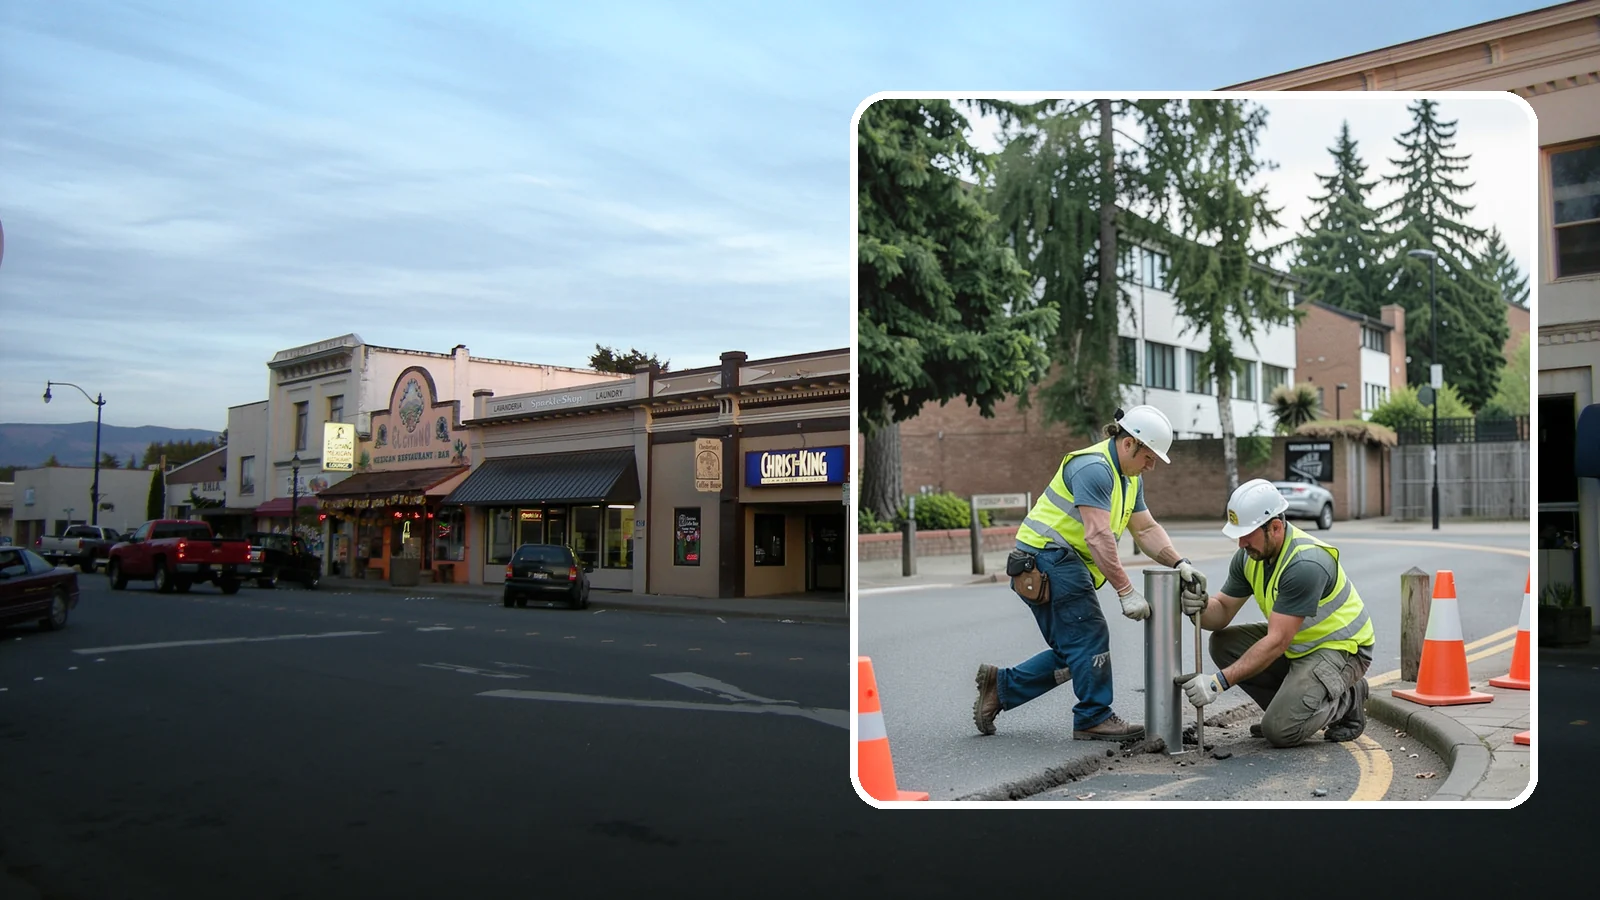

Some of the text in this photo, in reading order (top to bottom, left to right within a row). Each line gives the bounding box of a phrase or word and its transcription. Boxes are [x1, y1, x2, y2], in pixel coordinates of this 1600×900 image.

[493, 402, 522, 412] LAVANDERIA
[596, 389, 623, 400] LAUNDRY
[373, 455, 396, 464] MEXICAN
[398, 451, 433, 462] RESTAURANT
[438, 450, 450, 459] BAR
[761, 450, 827, 478] CHRIST KING
[697, 480, 722, 489] Coffee House
